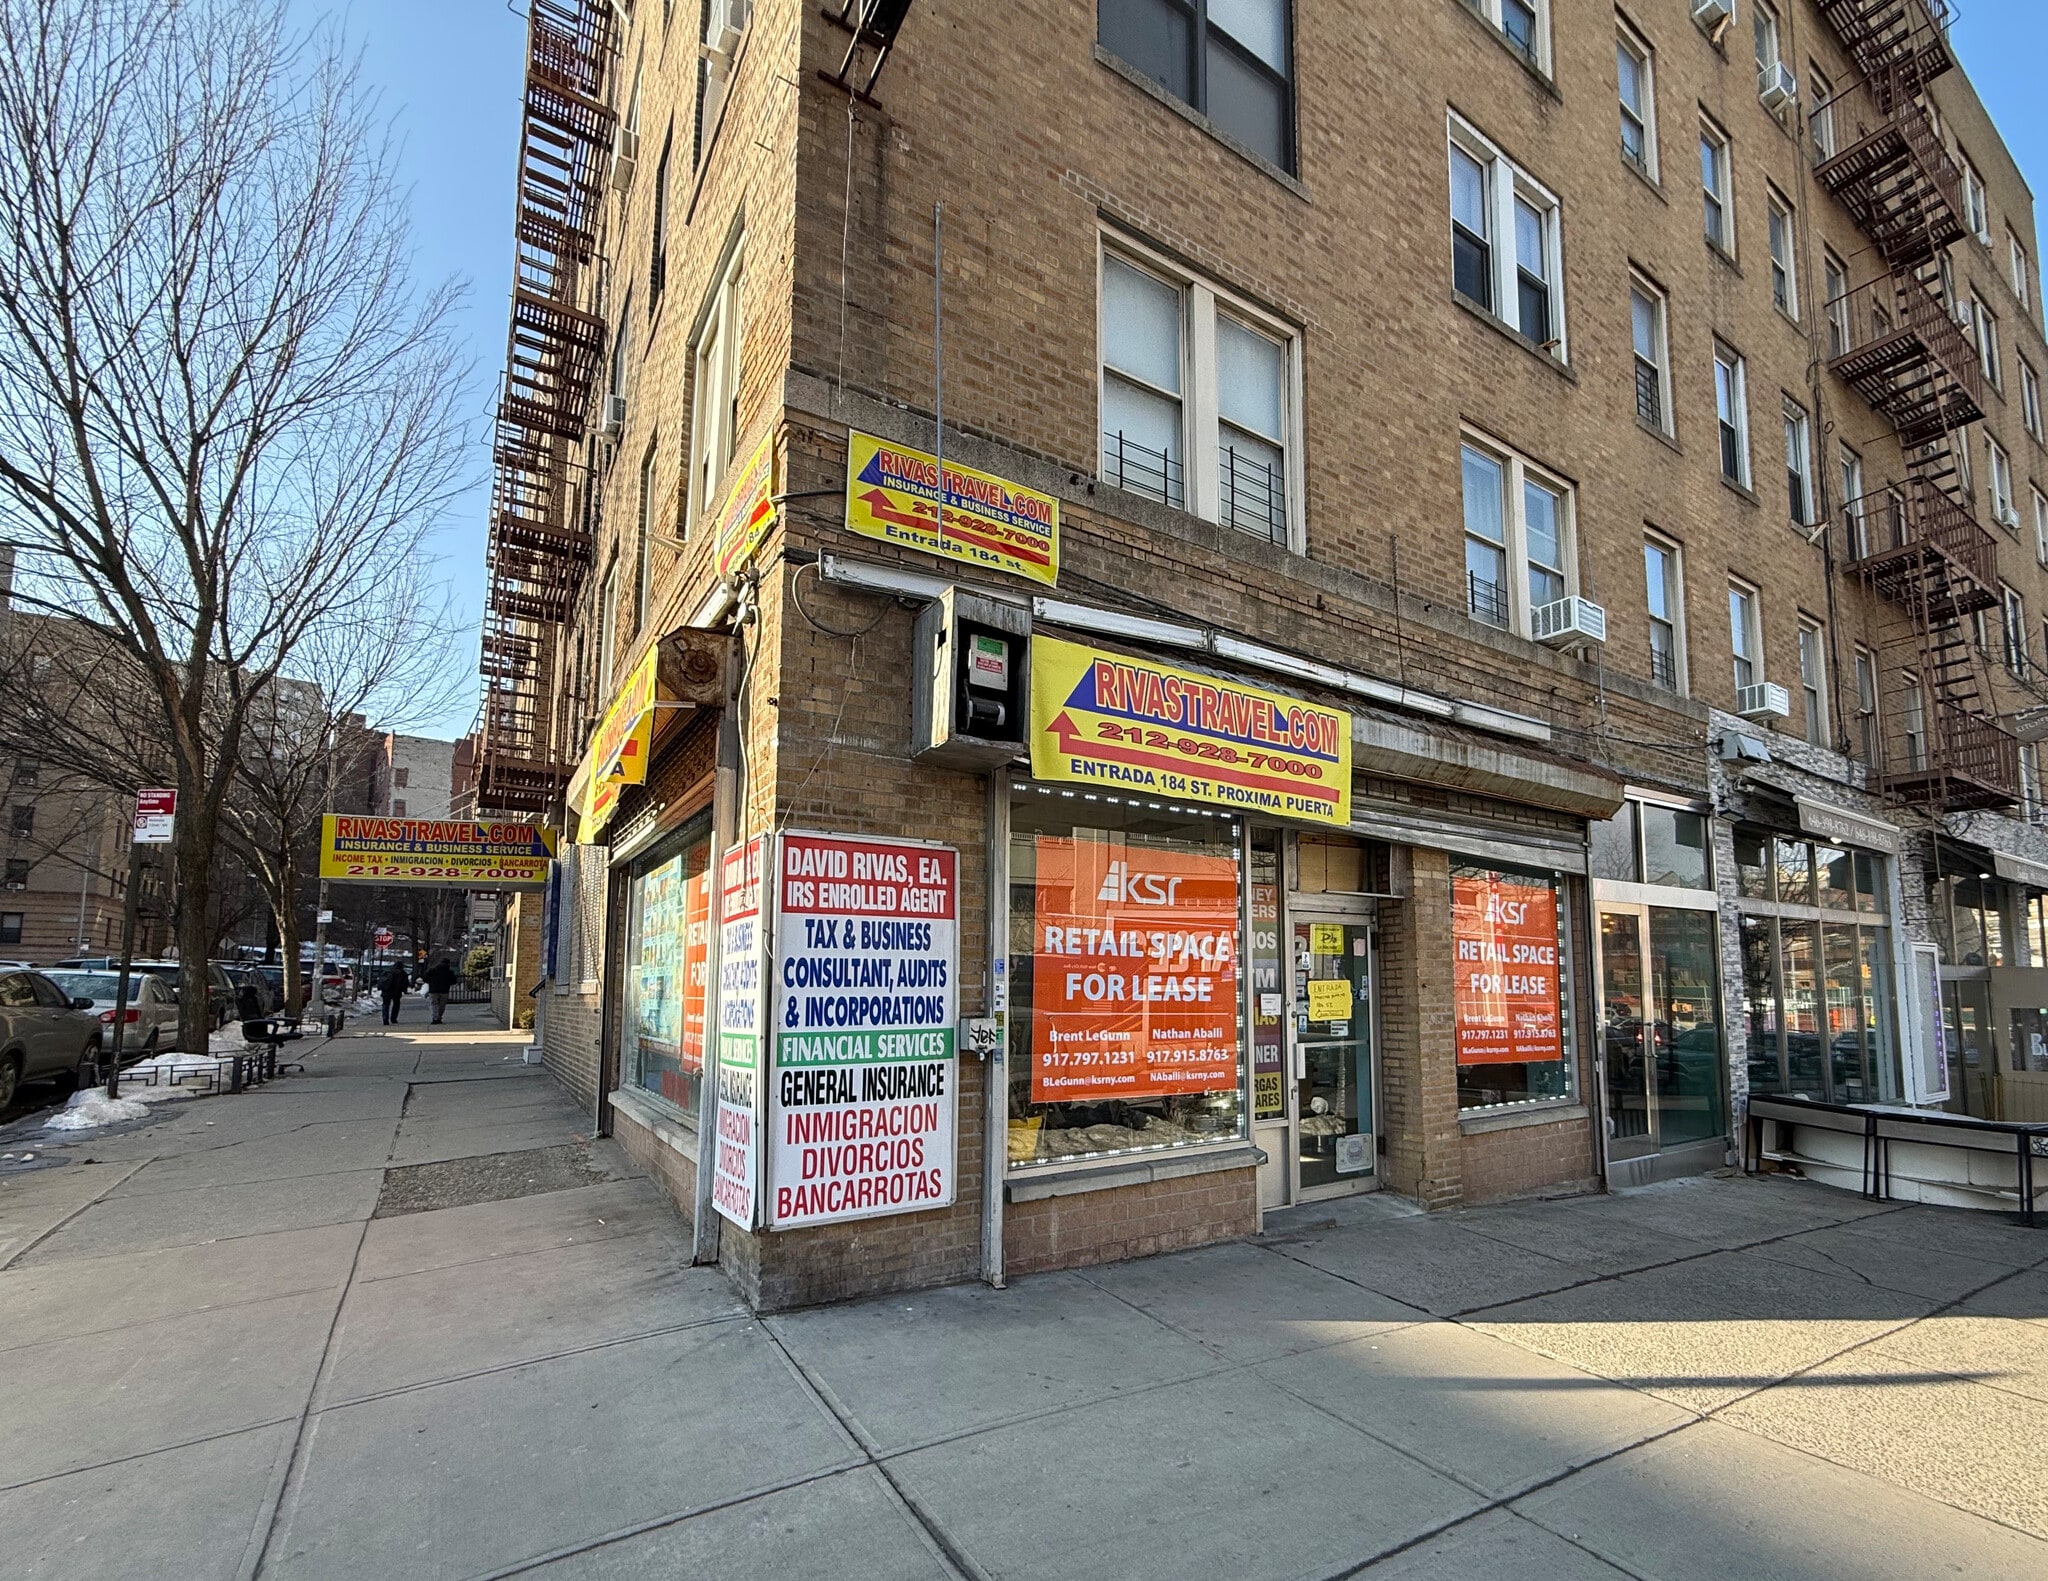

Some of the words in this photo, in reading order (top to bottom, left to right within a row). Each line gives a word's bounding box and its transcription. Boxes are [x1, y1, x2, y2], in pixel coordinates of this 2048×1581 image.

[879, 448, 1052, 525] RIVASTRAVEL.COM
[883, 475, 948, 503] INSURANCE
[951, 495, 958, 506] &
[961, 498, 1010, 522] BUSINESS
[1012, 515, 1051, 537] SERVICE
[912, 501, 1050, 552] 212-928-7000
[886, 525, 963, 553] Entrada
[970, 547, 1000, 564] 184
[1006, 560, 1026, 572] st.
[1094, 659, 1339, 756] RIVASTRAVEL.COM
[1097, 721, 1323, 779] 212-928-7000
[1070, 758, 1156, 786] ENTRADA
[1160, 774, 1186, 794] 184
[1190, 783, 1212, 798] ST.
[1217, 785, 1281, 808] PROXIMA
[1286, 796, 1334, 818] PUERTA
[336, 816, 534, 845] RIVASTRAVEL.COM
[333, 854, 365, 863] INCOME
[367, 855, 383, 864] TAX
[391, 856, 443, 865] INMIGRACION
[451, 857, 492, 866] DIVORCIOS
[341, 840, 410, 852] INSURANCE
[414, 843, 422, 852] &
[426, 843, 483, 854] BUSINESS
[486, 845, 532, 855] SERVICE
[347, 865, 534, 879] 212-928-7000
[787, 847, 848, 877] DAVID
[853, 855, 913, 887] RIVAS,
[787, 880, 815, 908] IRS
[819, 882, 896, 911] ENROLLED
[901, 887, 947, 914] AGENT
[805, 918, 838, 949] TAX
[843, 918, 856, 950] &
[861, 922, 932, 951] BUSINESS
[1045, 926, 1143, 957] RETAIL
[1151, 933, 1230, 961] SPACE
[1459, 939, 1510, 963] RETAIL
[1512, 945, 1554, 965] SPACE
[784, 956, 894, 993] CONSULTANT,
[897, 959, 947, 988] AUDITS
[1066, 973, 1125, 1001] FOR
[1132, 975, 1212, 1002] LEASE
[1470, 973, 1501, 995] FOR
[1504, 975, 1546, 995] LEASE
[785, 996, 800, 1028] &
[805, 995, 944, 1027] INCORPORATIONS
[782, 1033, 873, 1062] FINANCIAL
[877, 1032, 945, 1058] SERVICES
[1050, 1030, 1083, 1042] Brent
[1086, 1030, 1130, 1042] LeGunn
[1152, 1028, 1191, 1040] Nathan
[1193, 1027, 1223, 1039] Aballi
[1461, 1029, 1508, 1040] 917.797.1231
[1042, 1050, 1135, 1067] 917.797.1231
[1147, 1048, 1228, 1063] 917.915.8763
[780, 1068, 857, 1107] GENERAL
[861, 1063, 945, 1102] INSURANCE
[1043, 1074, 1135, 1087] BLeGunn@ksrny.com
[1150, 1069, 1225, 1082] NAballi@ksrny.com
[786, 1103, 938, 1145] INMIGRACION
[801, 1137, 924, 1180] DIVORCIOS
[777, 1168, 942, 1219] BANCARROTAS
